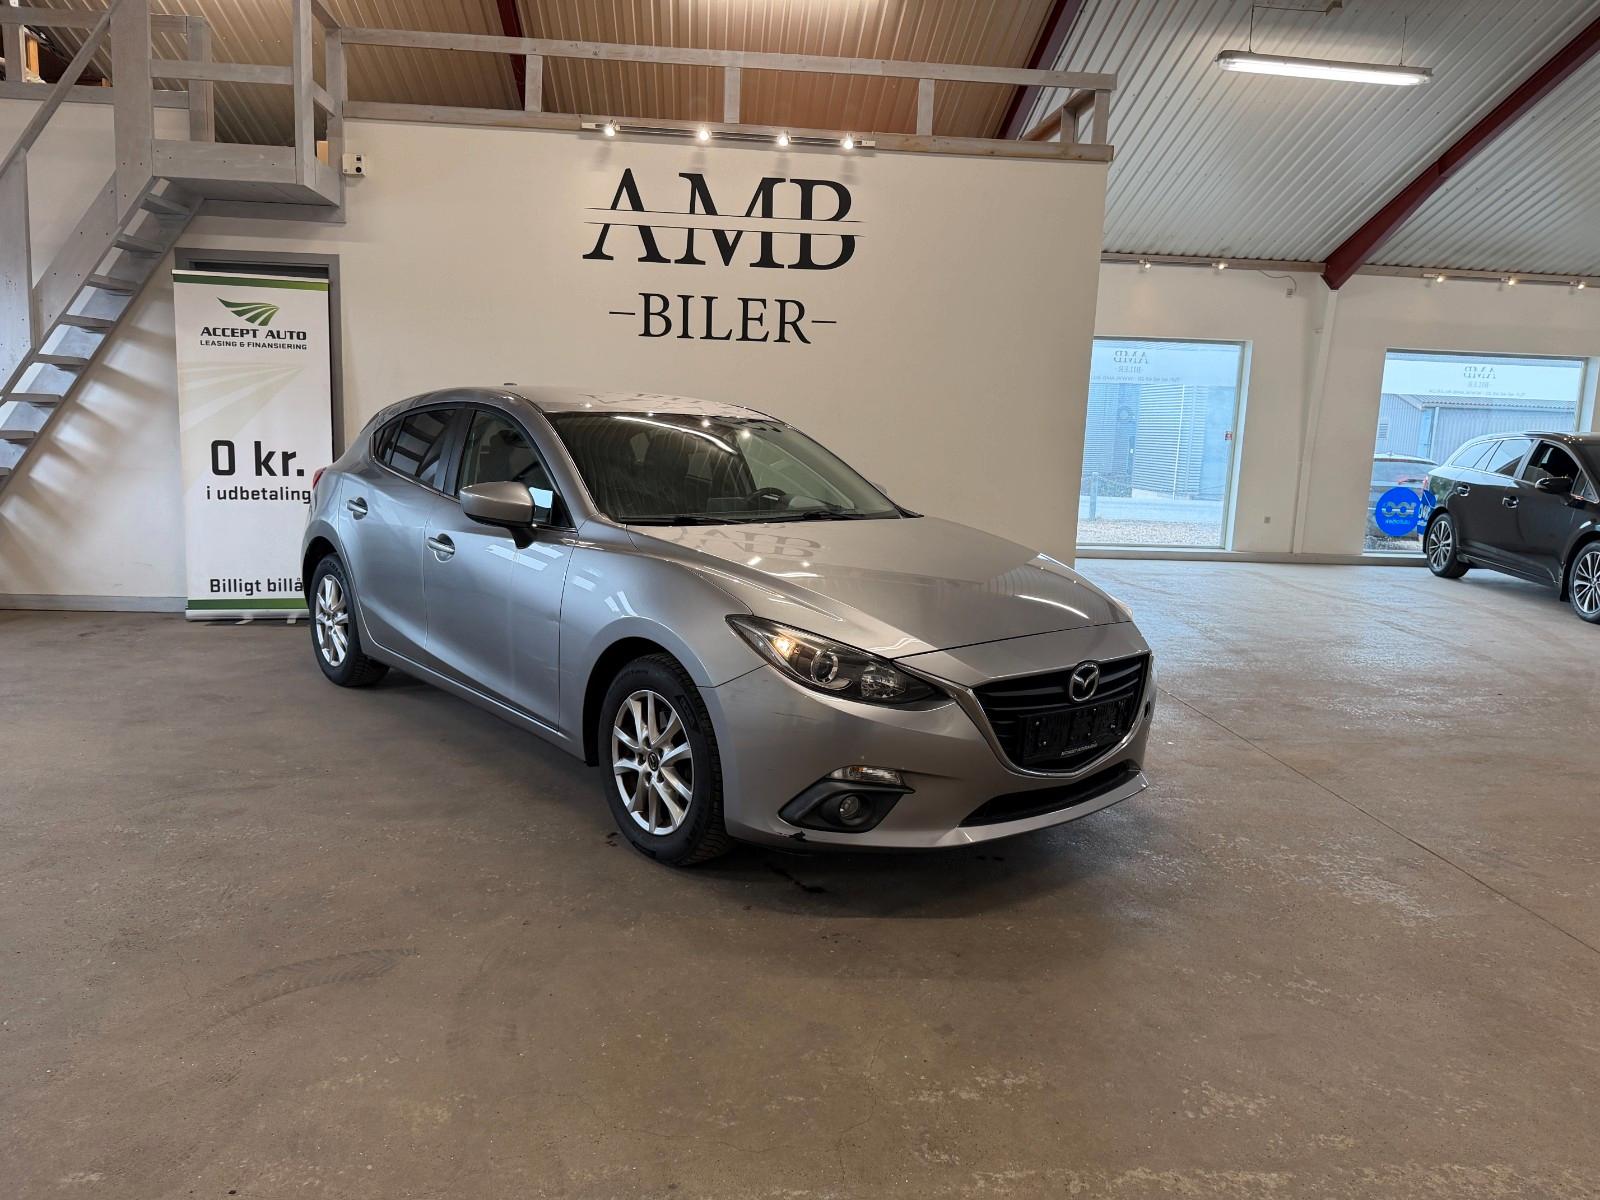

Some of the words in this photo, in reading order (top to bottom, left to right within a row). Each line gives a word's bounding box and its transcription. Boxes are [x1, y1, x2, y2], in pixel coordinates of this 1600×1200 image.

[582, 168, 856, 270] AMB
[200, 326, 260, 338] ACCEPT
[265, 329, 307, 341] AUTO
[200, 339, 237, 348] LEASING
[247, 341, 307, 350] FINANSIERING
[210, 439, 236, 476] 0
[253, 440, 305, 477] kr.
[206, 485, 211, 500] i
[216, 486, 311, 504] udbetaling
[209, 578, 261, 596] Billigt
